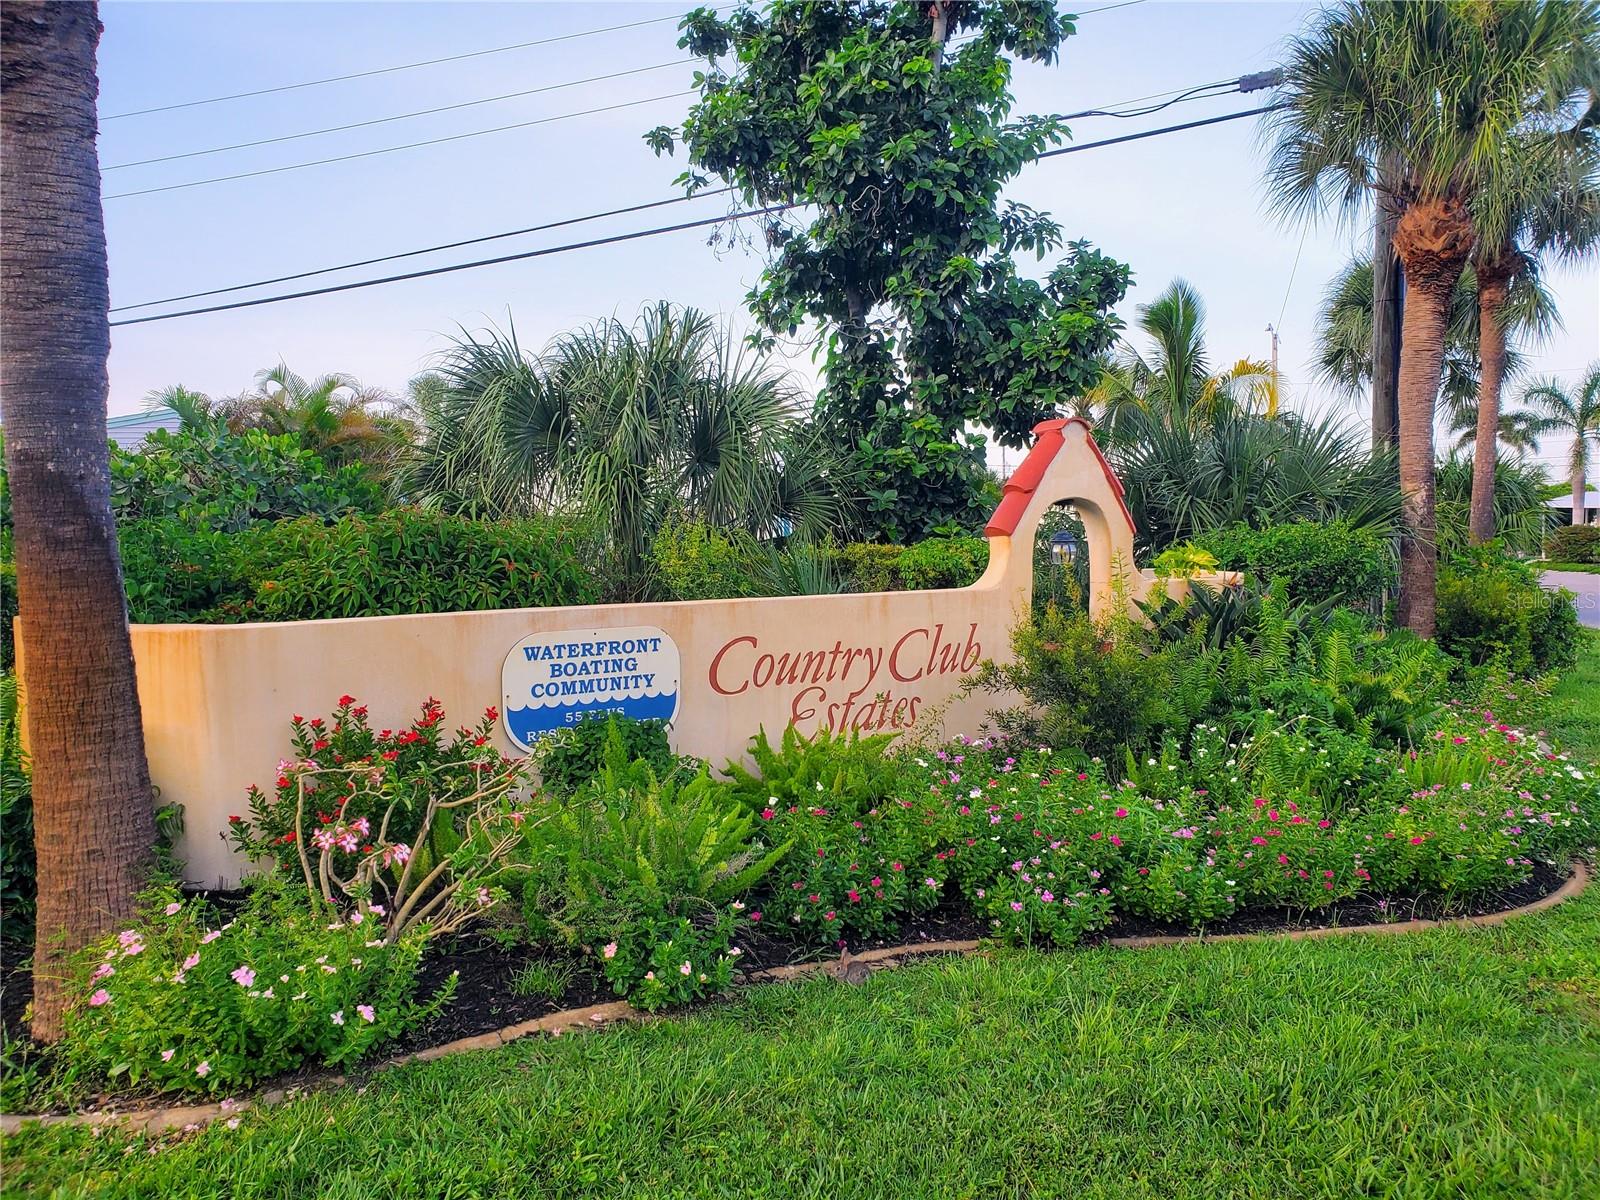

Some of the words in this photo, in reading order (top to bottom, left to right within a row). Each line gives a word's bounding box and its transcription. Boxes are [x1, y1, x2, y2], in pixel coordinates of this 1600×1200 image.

[523, 637, 661, 662] WATERFRONT
[708, 634, 883, 700] Country
[888, 623, 982, 683] Club
[549, 657, 638, 679] BOATING
[530, 673, 656, 699] COMMUNITY
[565, 711, 583, 723] 55
[787, 686, 922, 742] Estates
